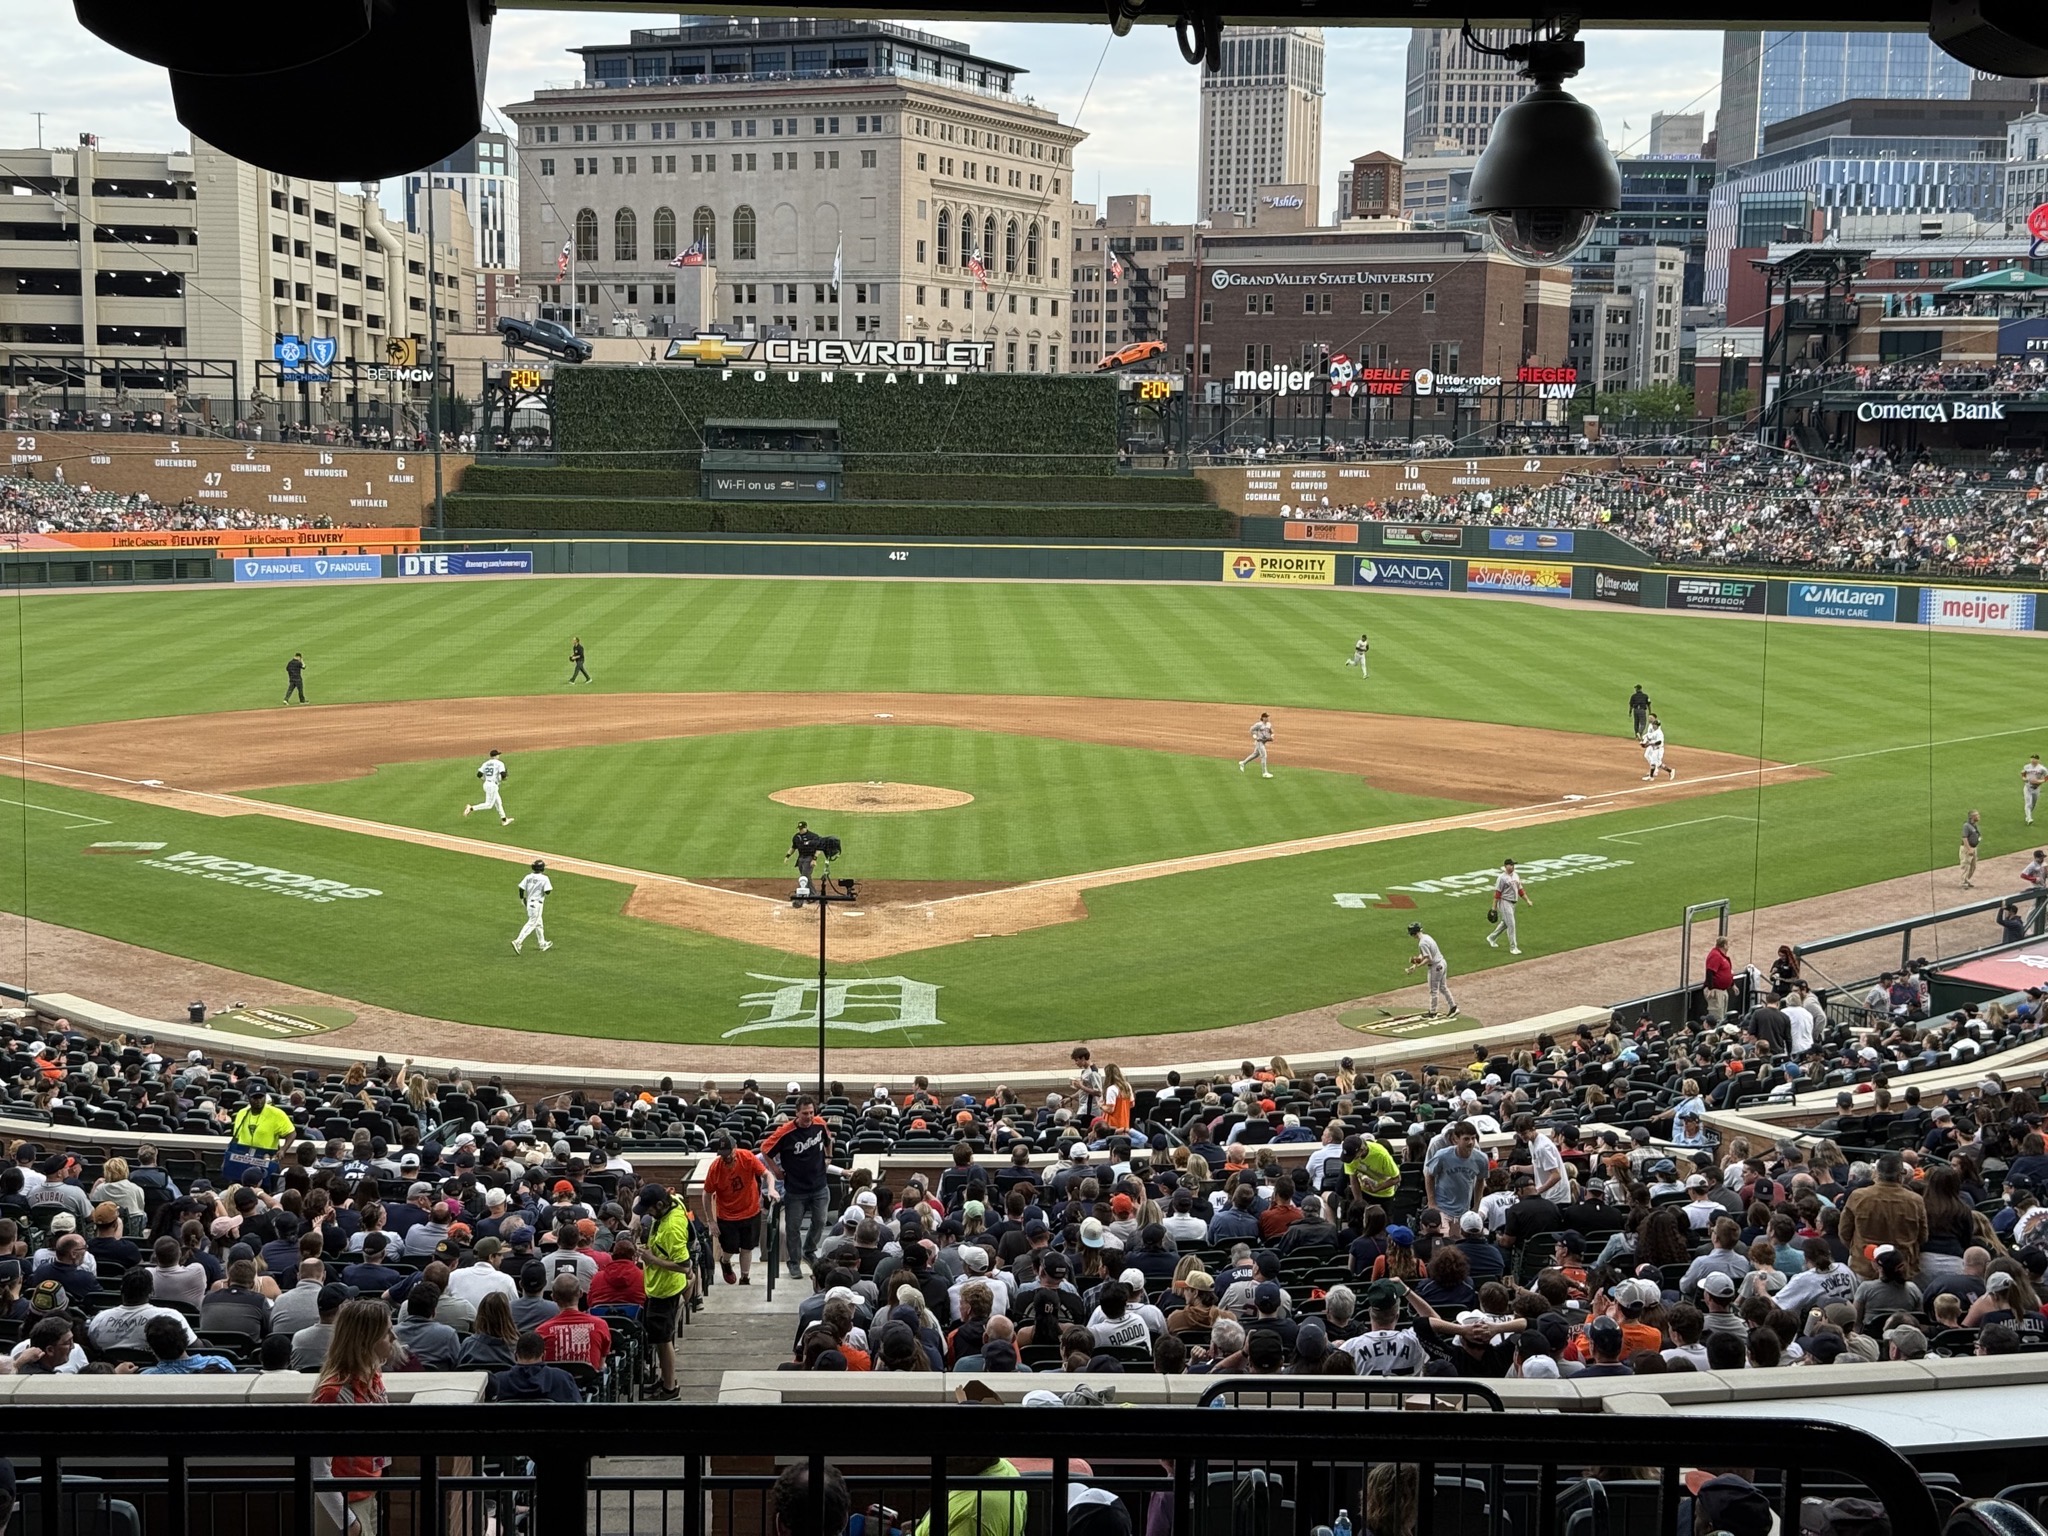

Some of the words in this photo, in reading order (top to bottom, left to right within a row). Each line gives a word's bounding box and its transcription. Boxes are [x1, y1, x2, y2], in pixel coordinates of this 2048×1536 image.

[1269, 195, 1304, 210] Ashley
[1357, 271, 1434, 284] UNIVERSITY
[764, 340, 994, 367] CHEVROLET
[284, 373, 331, 383] MICHIGAN
[367, 368, 434, 382] BETMGM
[510, 370, 540, 388] 2:04
[722, 370, 957, 385] FOUNTAIN
[1234, 364, 1314, 396] meijer
[1362, 368, 1411, 381] BELLE
[1517, 367, 1577, 383] FIEGER
[1140, 381, 1171, 398] 2:04
[1367, 382, 1403, 395] TIRE
[1539, 383, 1577, 399] LAW
[1951, 401, 2005, 420] Bank
[17, 437, 36, 450] 23
[171, 441, 180, 453] 5
[11, 454, 43, 463] HORTON
[246, 448, 255, 460] 2
[320, 451, 333, 465] 16
[155, 459, 197, 467] GREENBERG
[231, 464, 271, 472] GEHRINGER
[397, 457, 405, 471] 6
[1465, 461, 1478, 475] 11
[1523, 460, 1541, 473] 42
[304, 469, 348, 478] NEWHOUSER
[389, 475, 415, 483] KALINE
[1246, 470, 1281, 478] HEILMANN
[1292, 470, 1326, 478] JENNINGS
[1339, 469, 1371, 478] HARWELL
[1404, 467, 1419, 479] 10
[204, 473, 222, 487] 47
[283, 478, 292, 491] 3
[717, 479, 745, 490] Wi-Fi
[748, 482, 761, 490] on
[764, 482, 776, 490] us
[1248, 481, 1278, 490] MANUSH
[1290, 482, 1328, 490] CRAWFORD
[1395, 482, 1426, 491] LEYLAND
[1452, 477, 1490, 485] ANDERSON
[199, 490, 228, 499] MORRIS
[366, 482, 372, 496] 1
[268, 495, 307, 504] TRAMMELL
[350, 499, 388, 508] WHITAKER
[1245, 493, 1281, 501] COCHRANE
[1300, 493, 1317, 501] KELL
[112, 537, 135, 547] Little
[136, 537, 167, 547] Caesars
[244, 535, 264, 545] Little
[265, 535, 294, 544] Caesars
[261, 564, 304, 574] FANDUEL
[330, 562, 372, 572] FANDUEL
[405, 556, 448, 575] DTE
[1260, 558, 1326, 571] PRIORITY
[1378, 565, 1444, 581] VANDA
[1475, 566, 1531, 586] Surfside
[1721, 583, 1755, 597] BET
[1686, 596, 1745, 606] SPORTSBOOK
[1822, 588, 1885, 606] McLaren
[1815, 607, 1845, 616] HEALTH
[1847, 609, 1868, 617] CARE
[1943, 596, 2010, 623] meijer
[164, 851, 383, 899] VICTORS
[1386, 853, 1608, 893] VICTORS
[1444, 880, 1498, 898] HOM
[794, 1130, 823, 1155] Detroit
[344, 1162, 369, 1172] GREENE
[35, 1192, 64, 1203] SKUBAL
[1232, 1269, 1253, 1279] SKUB
[1821, 1273, 1850, 1293] POWERS
[105, 1316, 148, 1329] PYRAMID
[1358, 1341, 1411, 1362] MEMA
